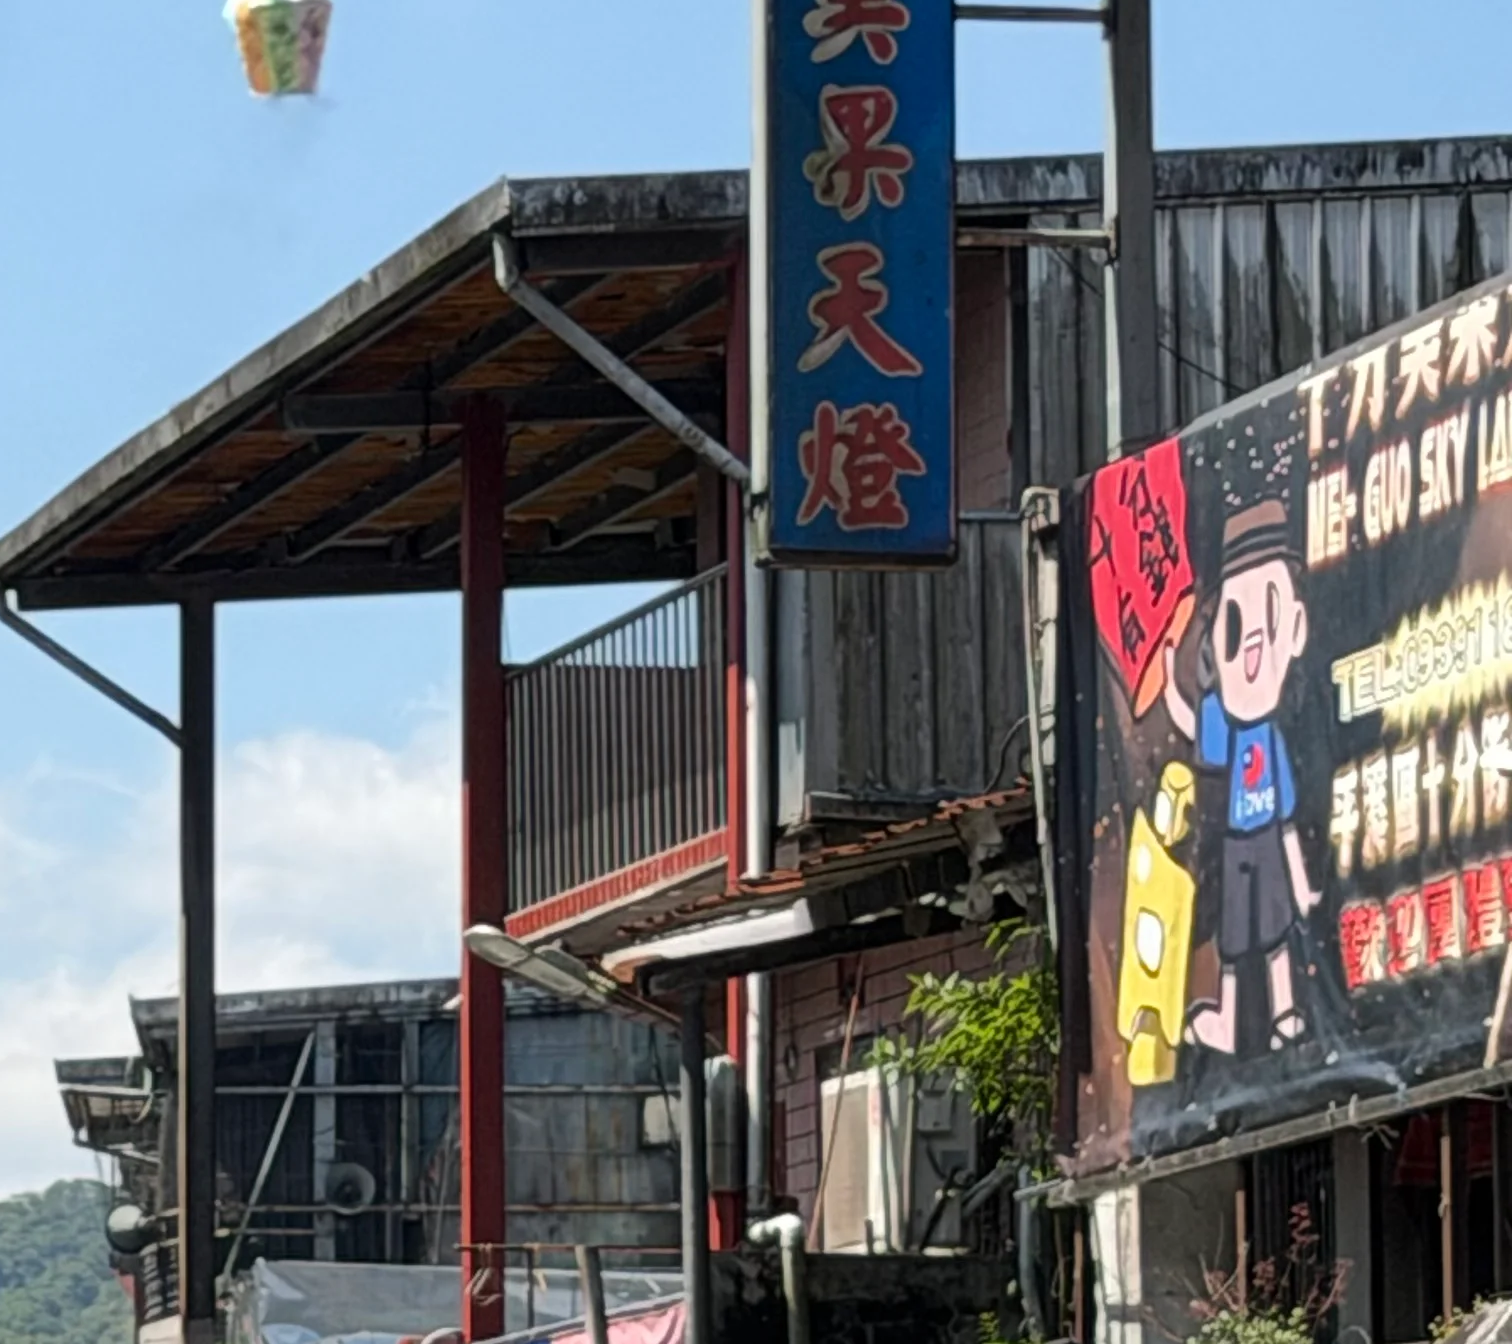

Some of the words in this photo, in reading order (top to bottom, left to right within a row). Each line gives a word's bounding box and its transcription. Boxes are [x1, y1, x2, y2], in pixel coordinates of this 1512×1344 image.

[1297, 284, 1512, 456] 十分美果
[1419, 398, 1471, 517] SKY
[1478, 389, 1512, 491] LA
[1340, 858, 1512, 991] 歡迎團體
